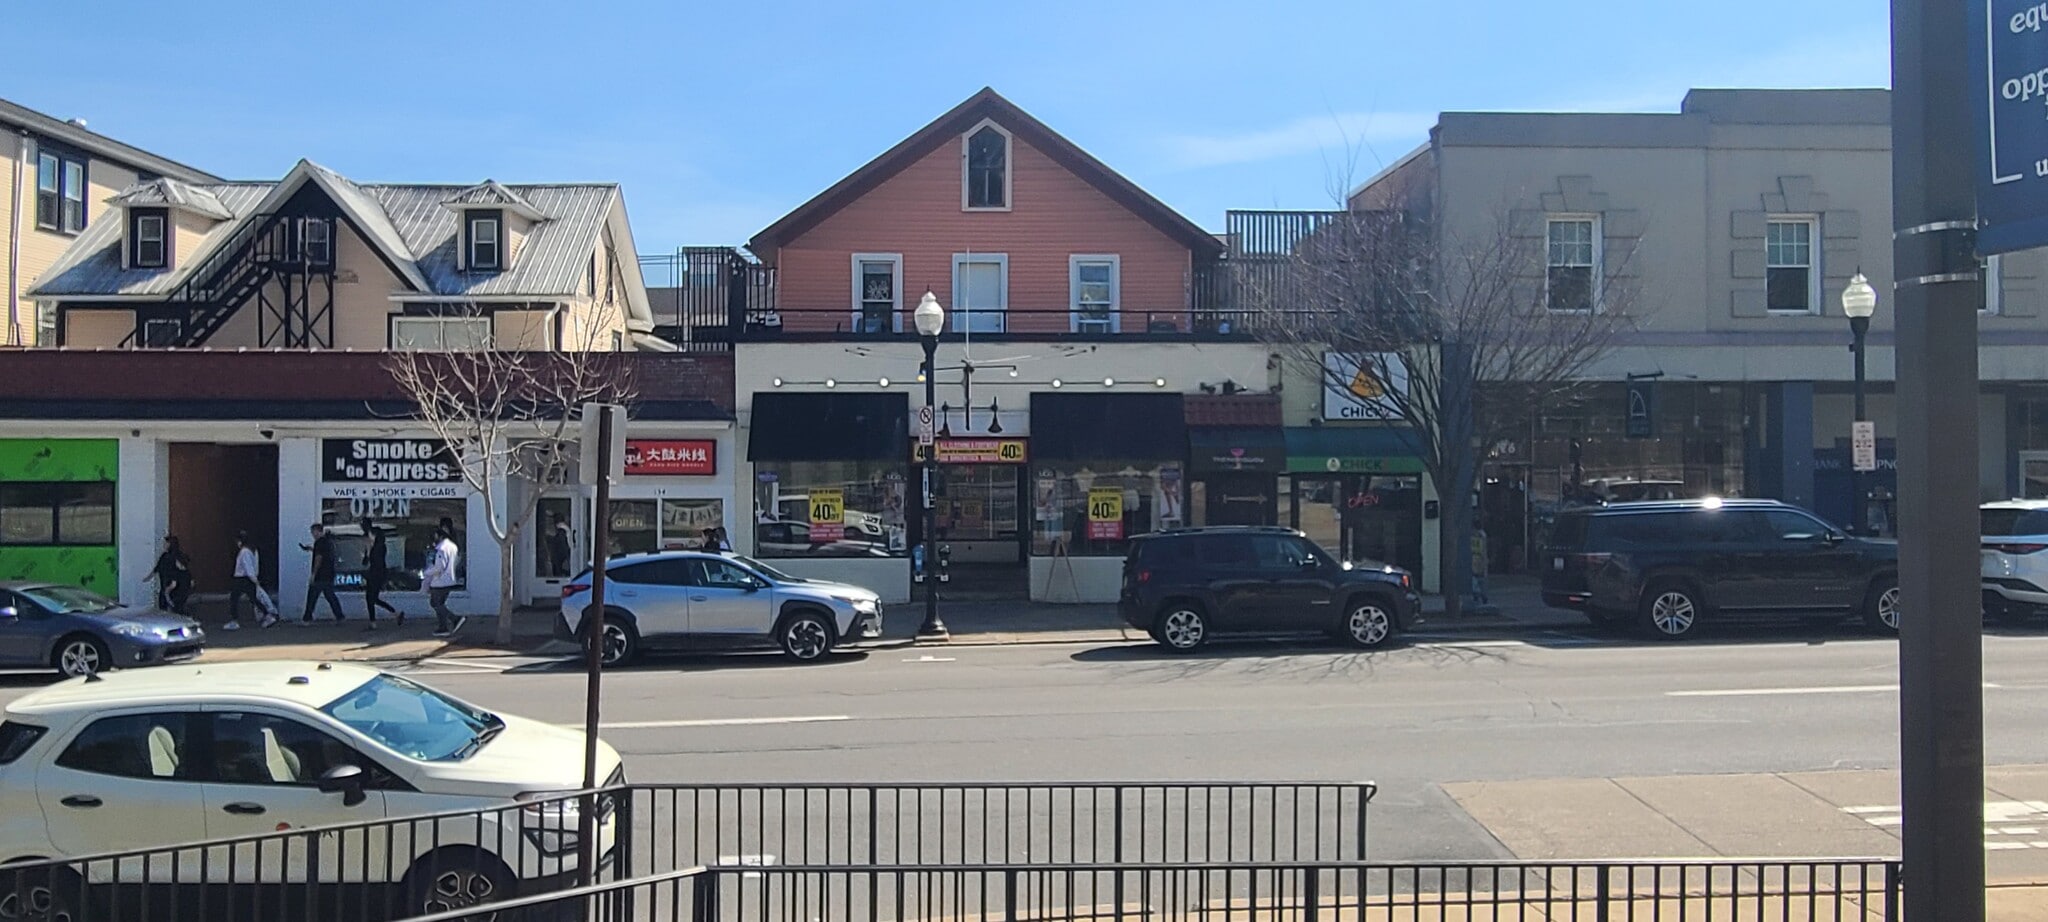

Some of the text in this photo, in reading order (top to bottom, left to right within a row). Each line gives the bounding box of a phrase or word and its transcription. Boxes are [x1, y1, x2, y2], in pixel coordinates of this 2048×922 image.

[352, 440, 432, 459] Smoke
[336, 457, 449, 482] N Go Express
[334, 488, 456, 496] VAPE SMOKE CIGARS
[350, 499, 410, 518] OPEN
